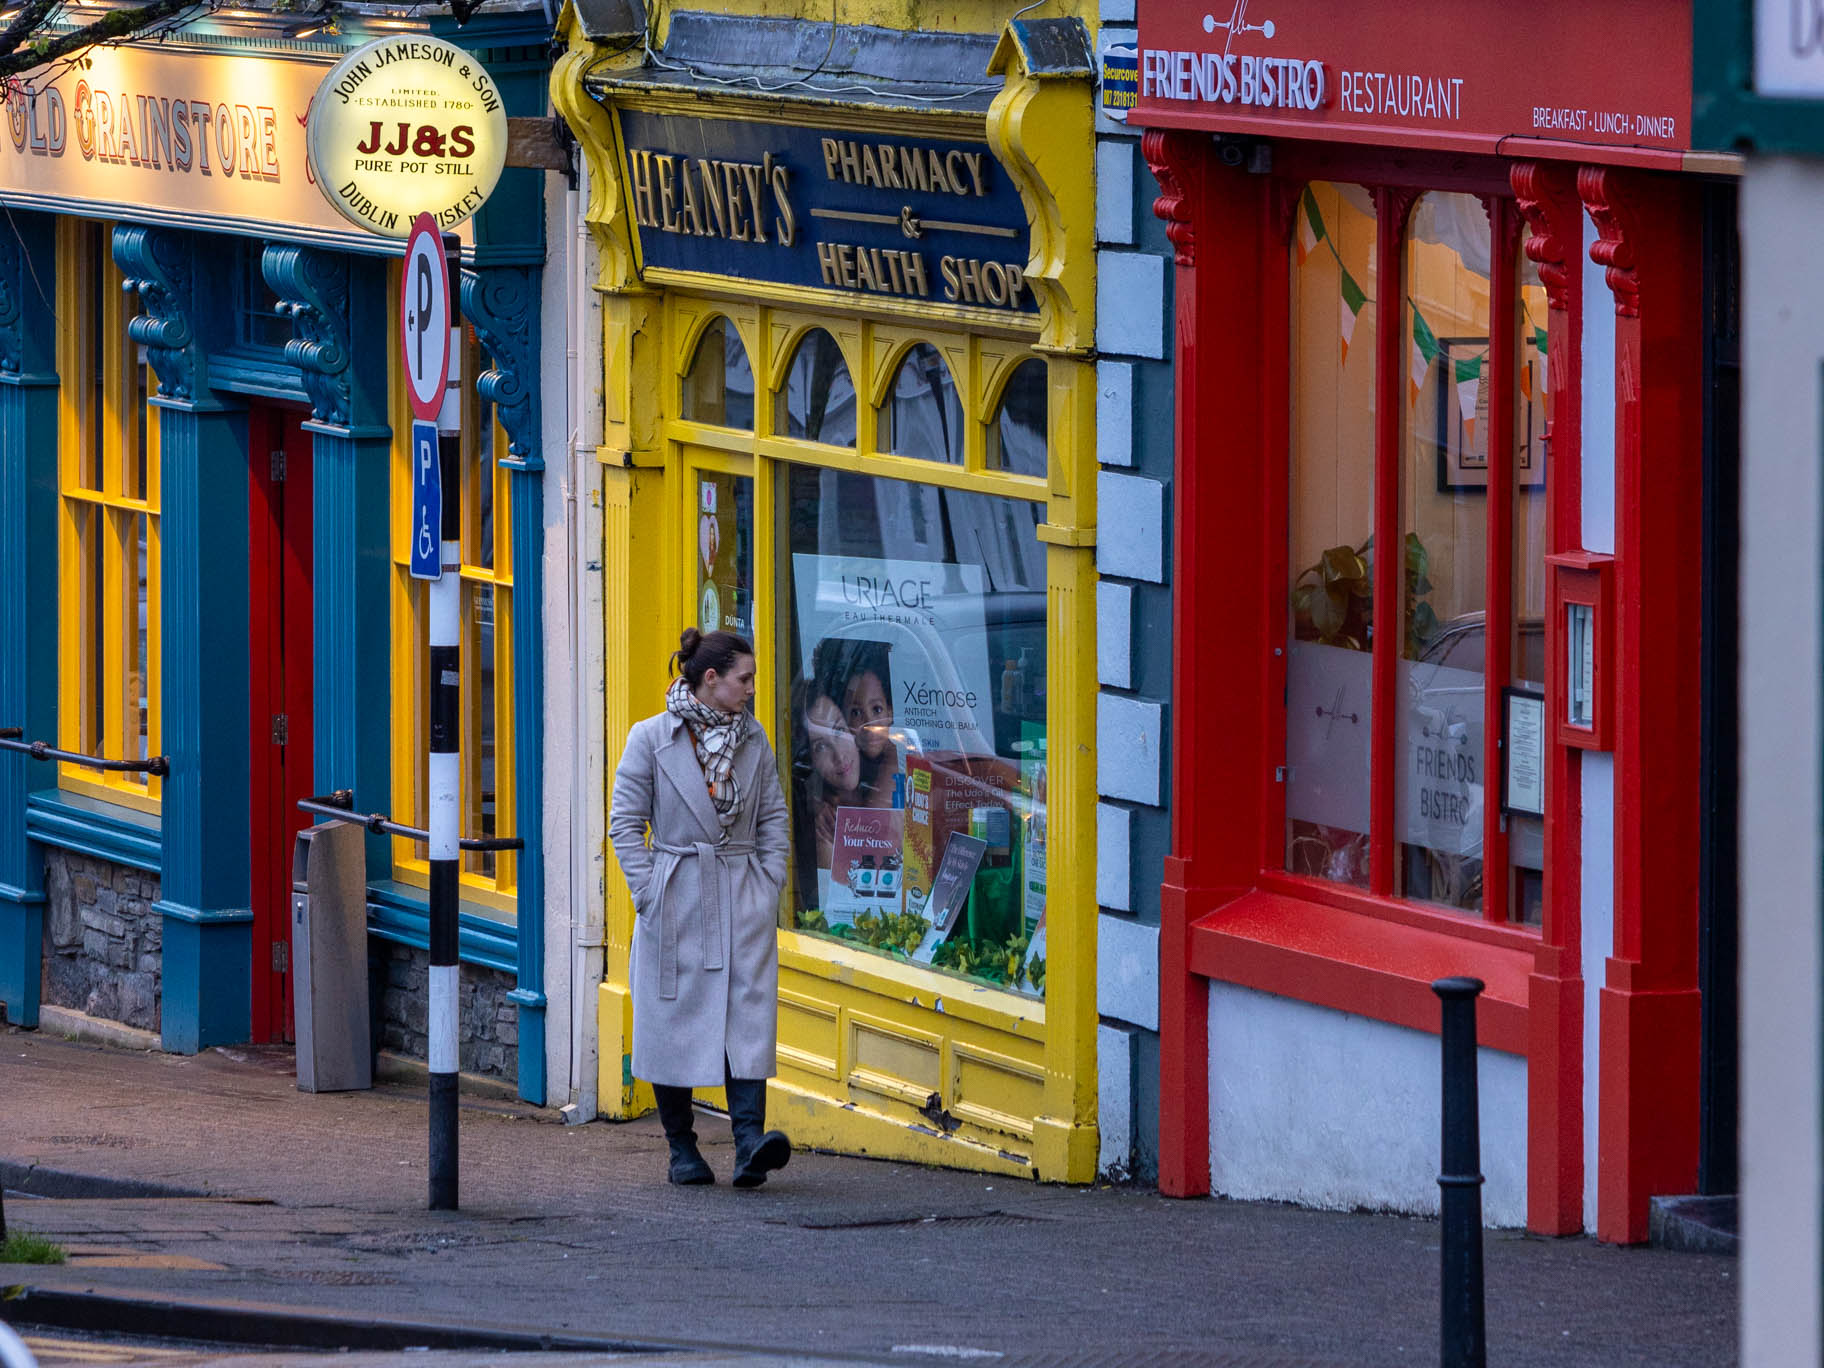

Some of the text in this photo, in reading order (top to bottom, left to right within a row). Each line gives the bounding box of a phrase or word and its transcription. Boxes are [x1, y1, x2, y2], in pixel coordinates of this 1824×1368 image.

[333, 43, 500, 114] JOHN JAMESON & SON
[1143, 49, 1464, 120] FRIENDS BISTRO RESTAURANT
[7, 74, 280, 182] OLD GRAINSTORE
[357, 121, 475, 158] JJ&S
[1533, 107, 1675, 138] BREAKFAST LUNCH DINNER
[355, 160, 474, 176] PURE POT STILL
[822, 138, 986, 197] PHARMACY
[339, 182, 399, 229] DUBLIN
[629, 149, 796, 247] HEANEY'S
[900, 206, 921, 239] &
[816, 242, 1024, 309] HEALTH SHOP
[417, 251, 433, 381] P
[421, 439, 431, 486] P
[841, 575, 934, 611] URIAGE
[845, 611, 935, 626] EAU THERMALE
[903, 680, 977, 709] Xémose
[905, 717, 944, 729] SOOTHING
[945, 775, 1004, 787] DISCOVER
[1416, 745, 1476, 783] FRIENDS
[1420, 788, 1470, 826] BISTRO
[843, 836, 893, 849] Your Stress
